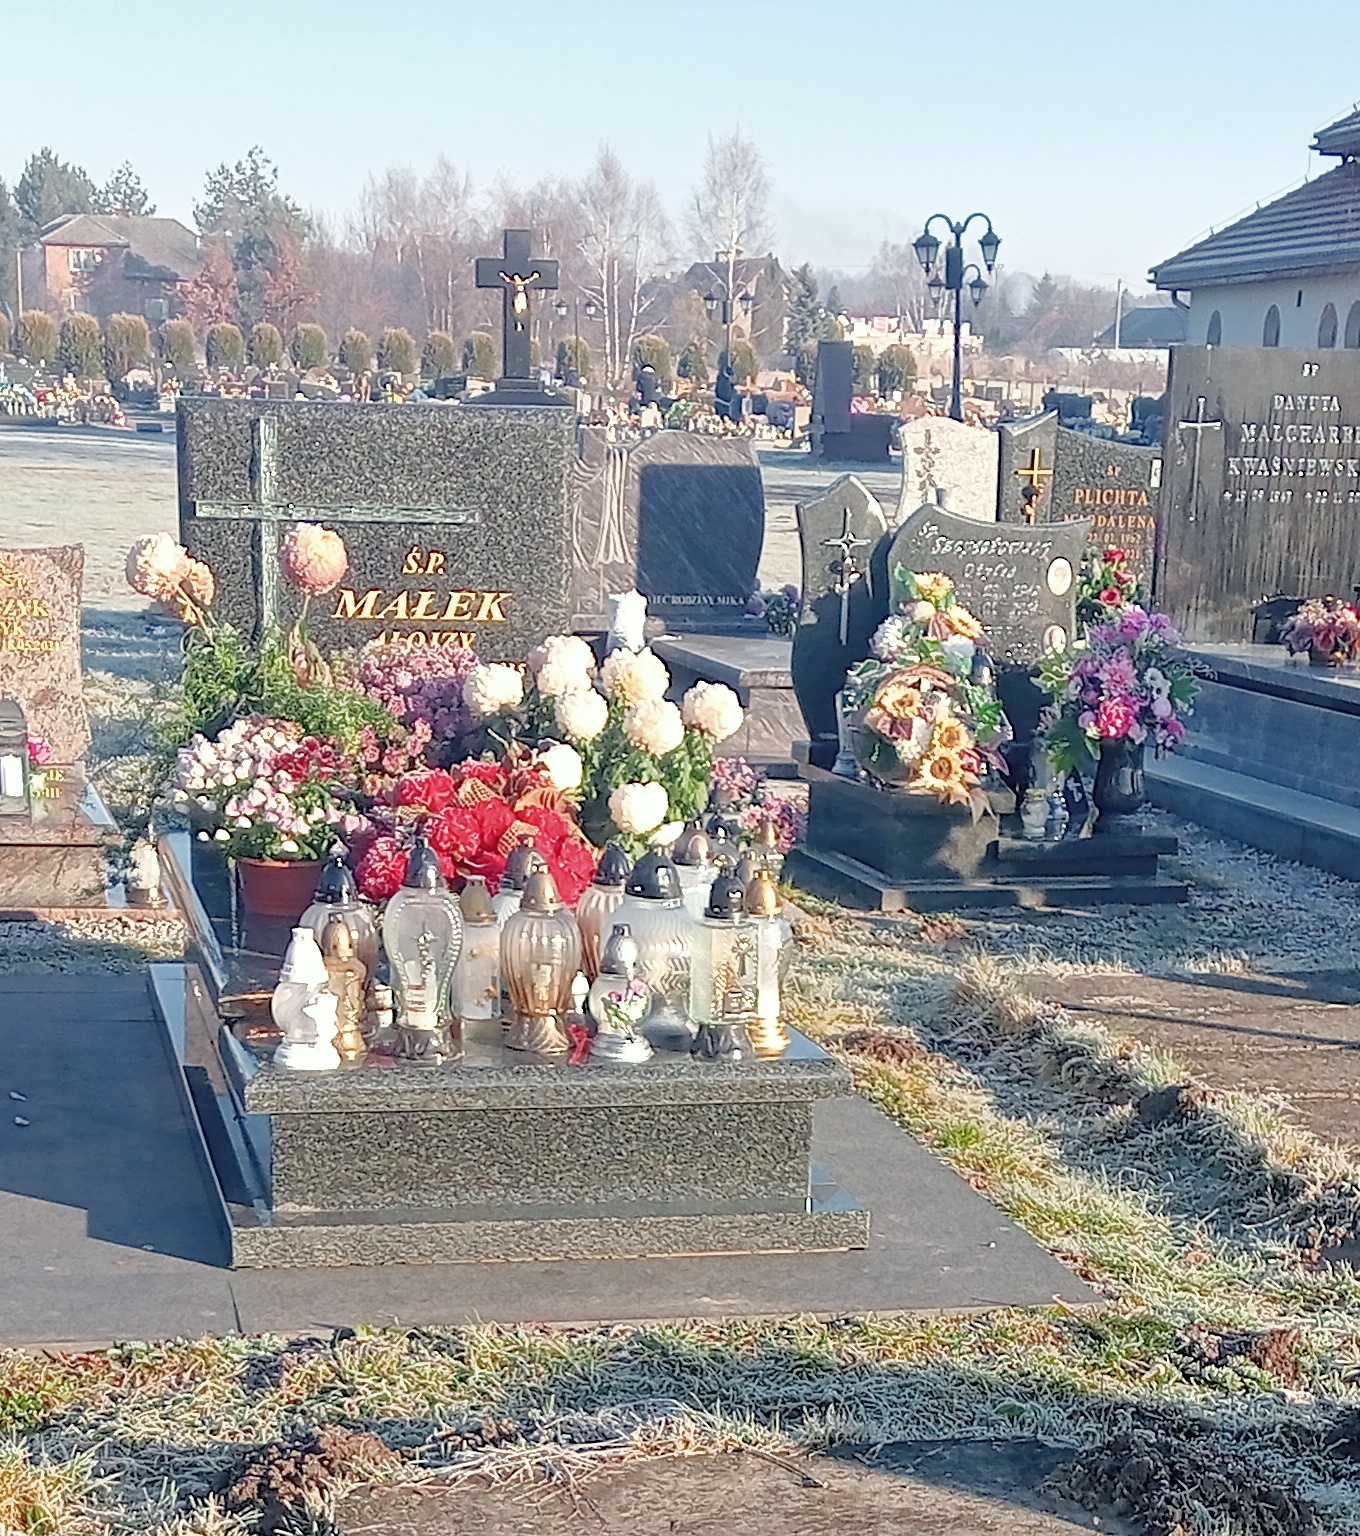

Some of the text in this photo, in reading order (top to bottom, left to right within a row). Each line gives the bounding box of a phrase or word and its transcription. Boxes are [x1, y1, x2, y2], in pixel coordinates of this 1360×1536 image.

[1273, 394, 1341, 412] DANUTA
[1073, 488, 1150, 507] PLICHTA
[402, 546, 447, 575] Ś.P.
[333, 588, 513, 622] MAŁEK
